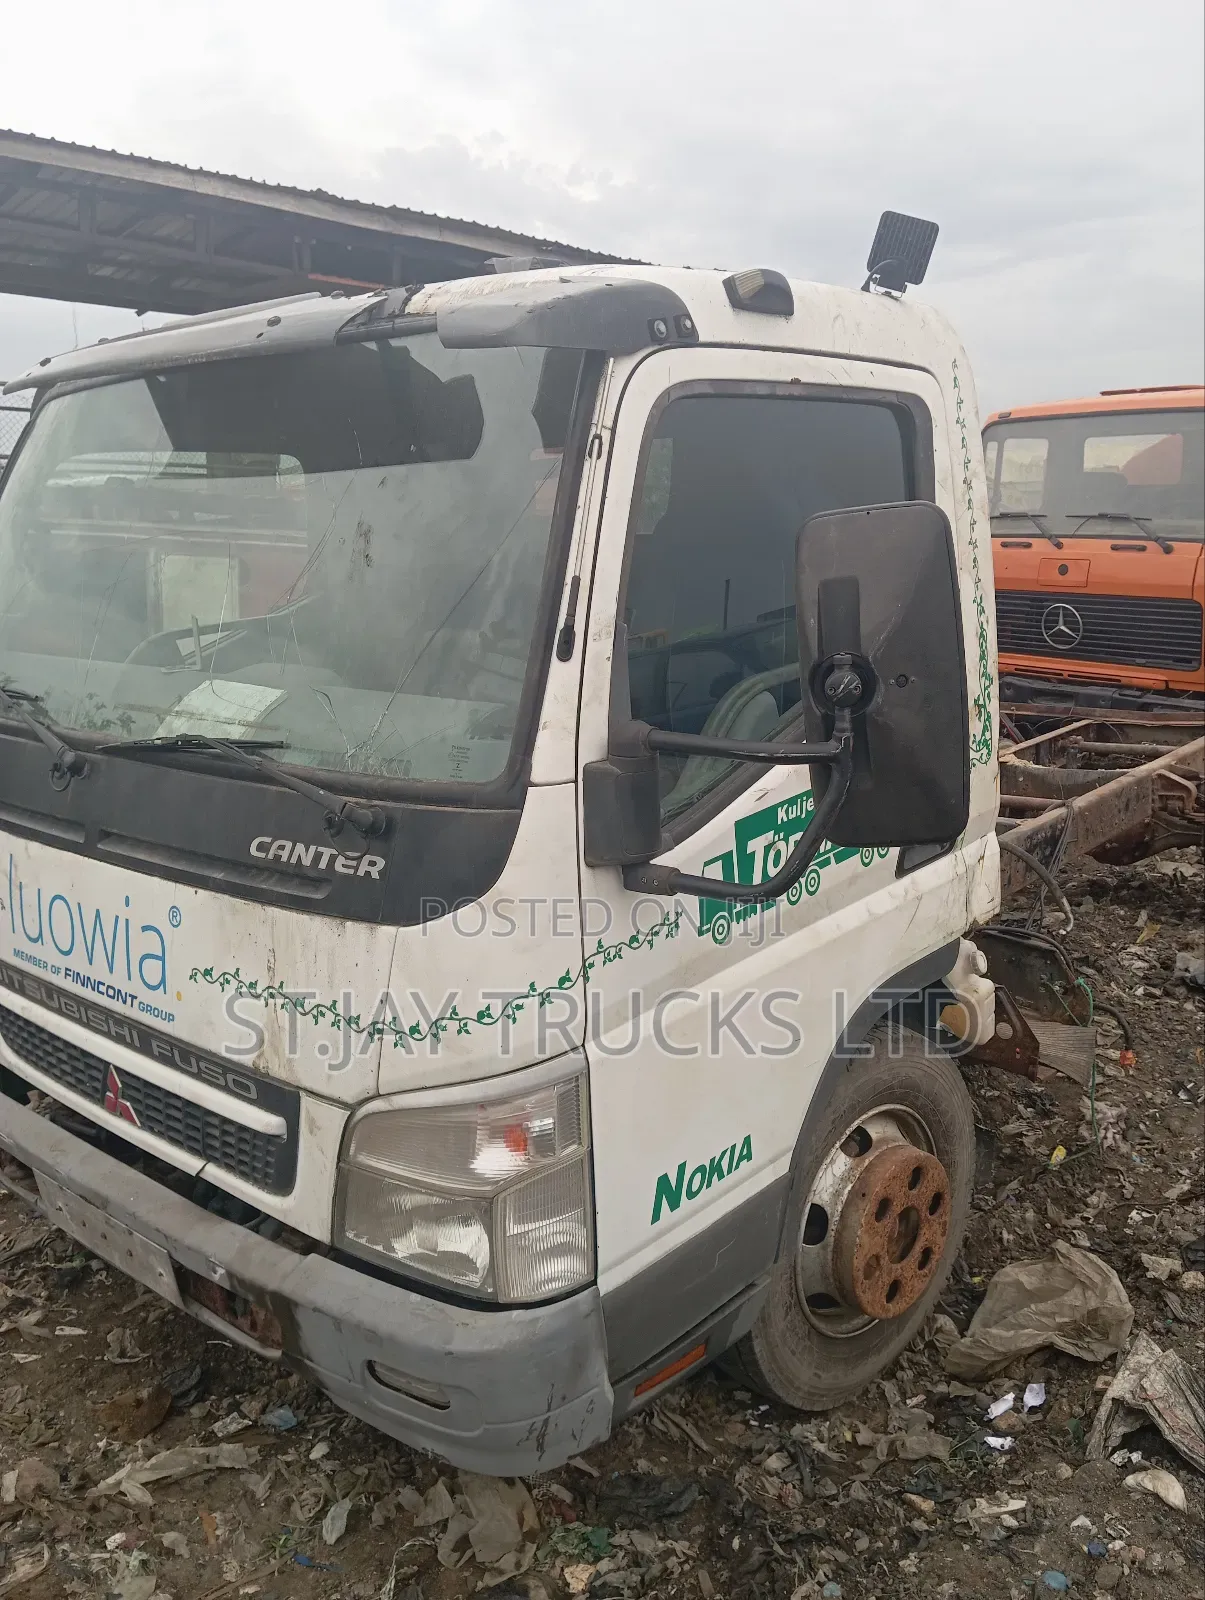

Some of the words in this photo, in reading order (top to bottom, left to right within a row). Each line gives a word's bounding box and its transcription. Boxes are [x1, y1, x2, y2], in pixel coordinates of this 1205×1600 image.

[249, 836, 386, 880] CANTER
[13, 948, 48, 971] MEMBER
[51, 964, 62, 976] OF
[64, 967, 138, 1008] FINNCONT
[138, 1001, 175, 1023] GROUP
[0, 967, 142, 1048] ITSUBISHI
[150, 1038, 258, 1100] FUSO
